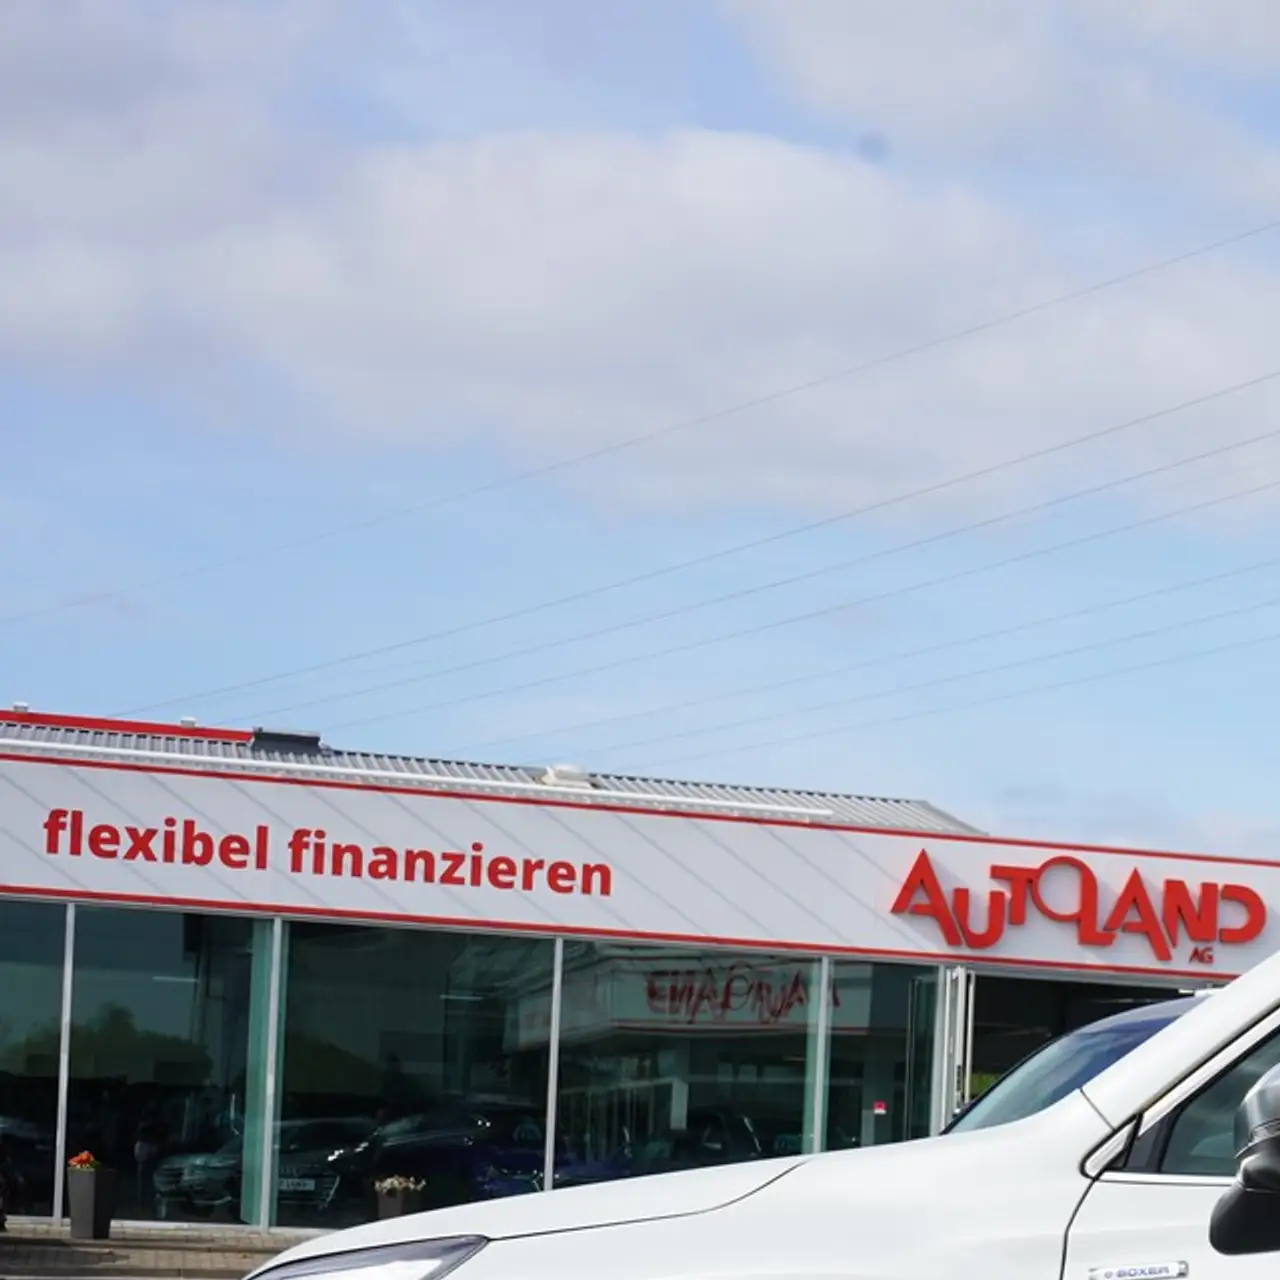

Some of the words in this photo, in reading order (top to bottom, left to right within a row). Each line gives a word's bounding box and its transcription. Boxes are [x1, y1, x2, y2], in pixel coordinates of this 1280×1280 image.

[43, 809, 268, 870] flexibel
[287, 828, 613, 896] finanzieren
[890, 848, 1267, 961] AUTOLAND
[1188, 946, 1215, 964] AG
